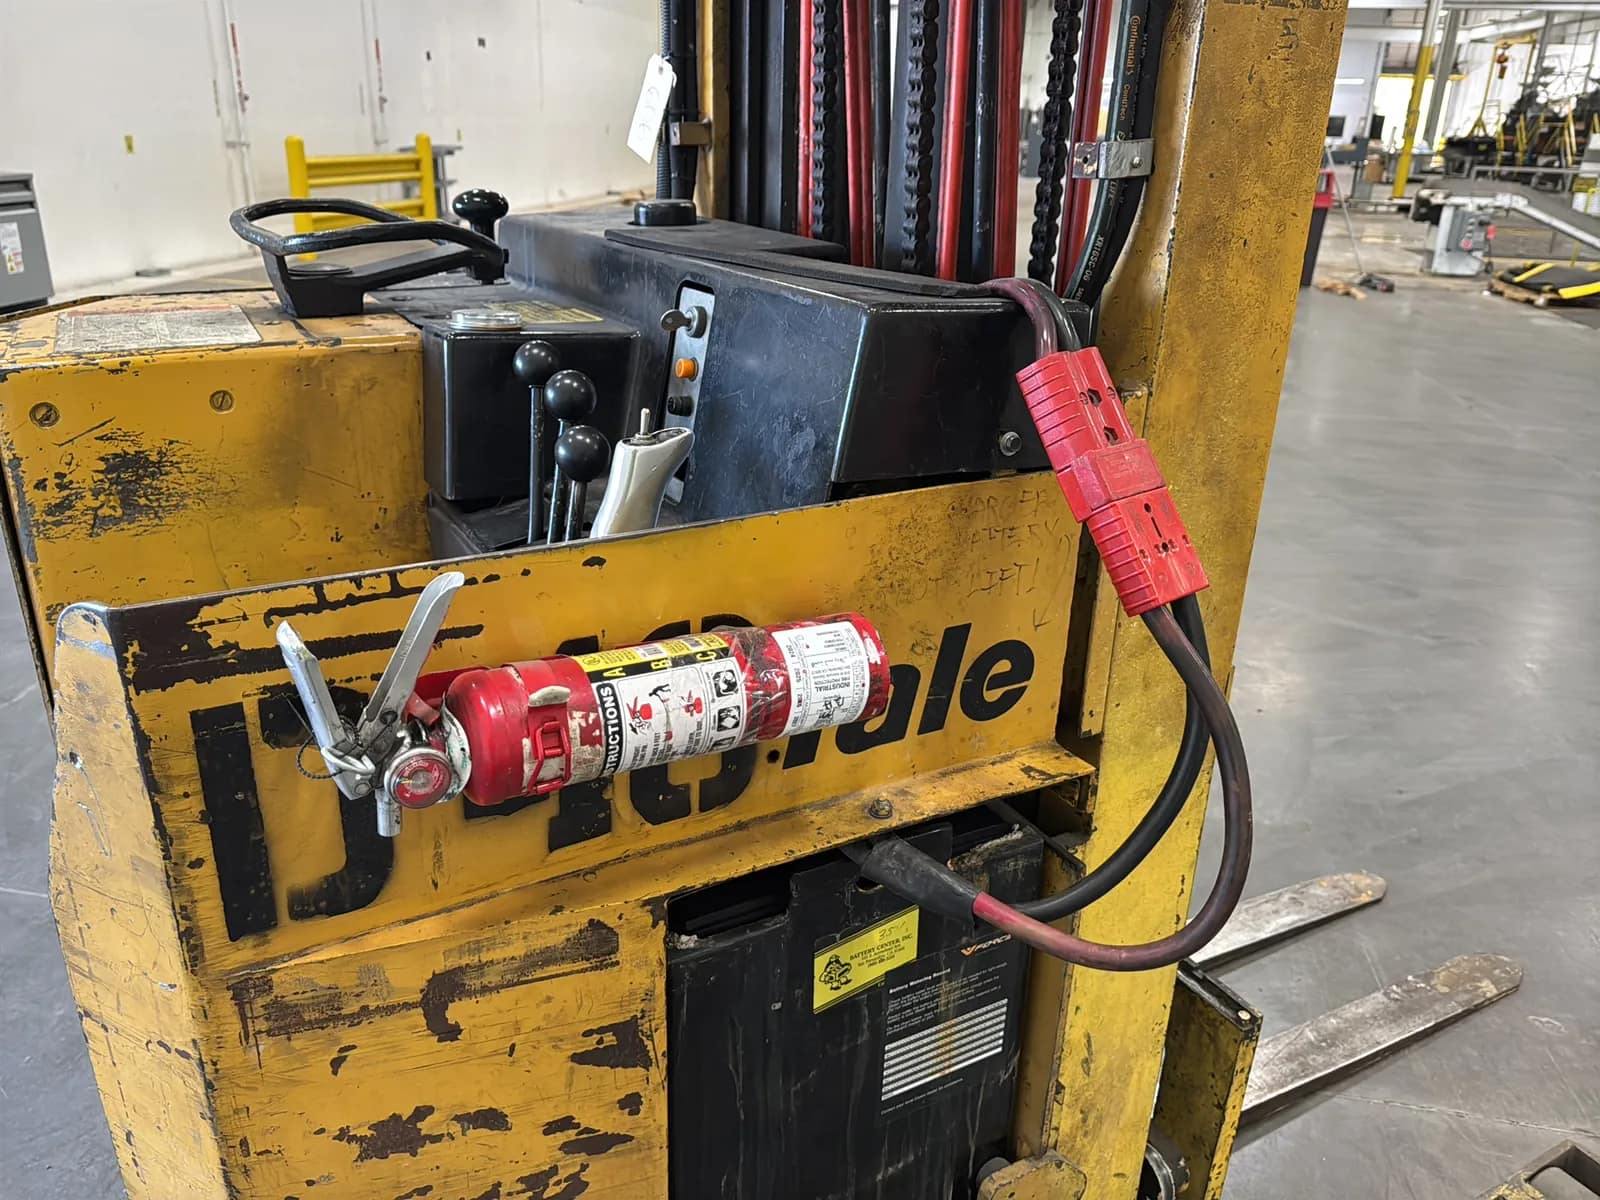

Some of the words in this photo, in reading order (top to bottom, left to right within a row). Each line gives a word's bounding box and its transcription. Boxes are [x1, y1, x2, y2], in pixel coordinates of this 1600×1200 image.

[1127, 15, 1142, 67] Continental
[1120, 84, 1131, 121] ContiTech
[603, 667, 627, 678] A
[650, 657, 673, 670] B
[696, 649, 717, 661] C
